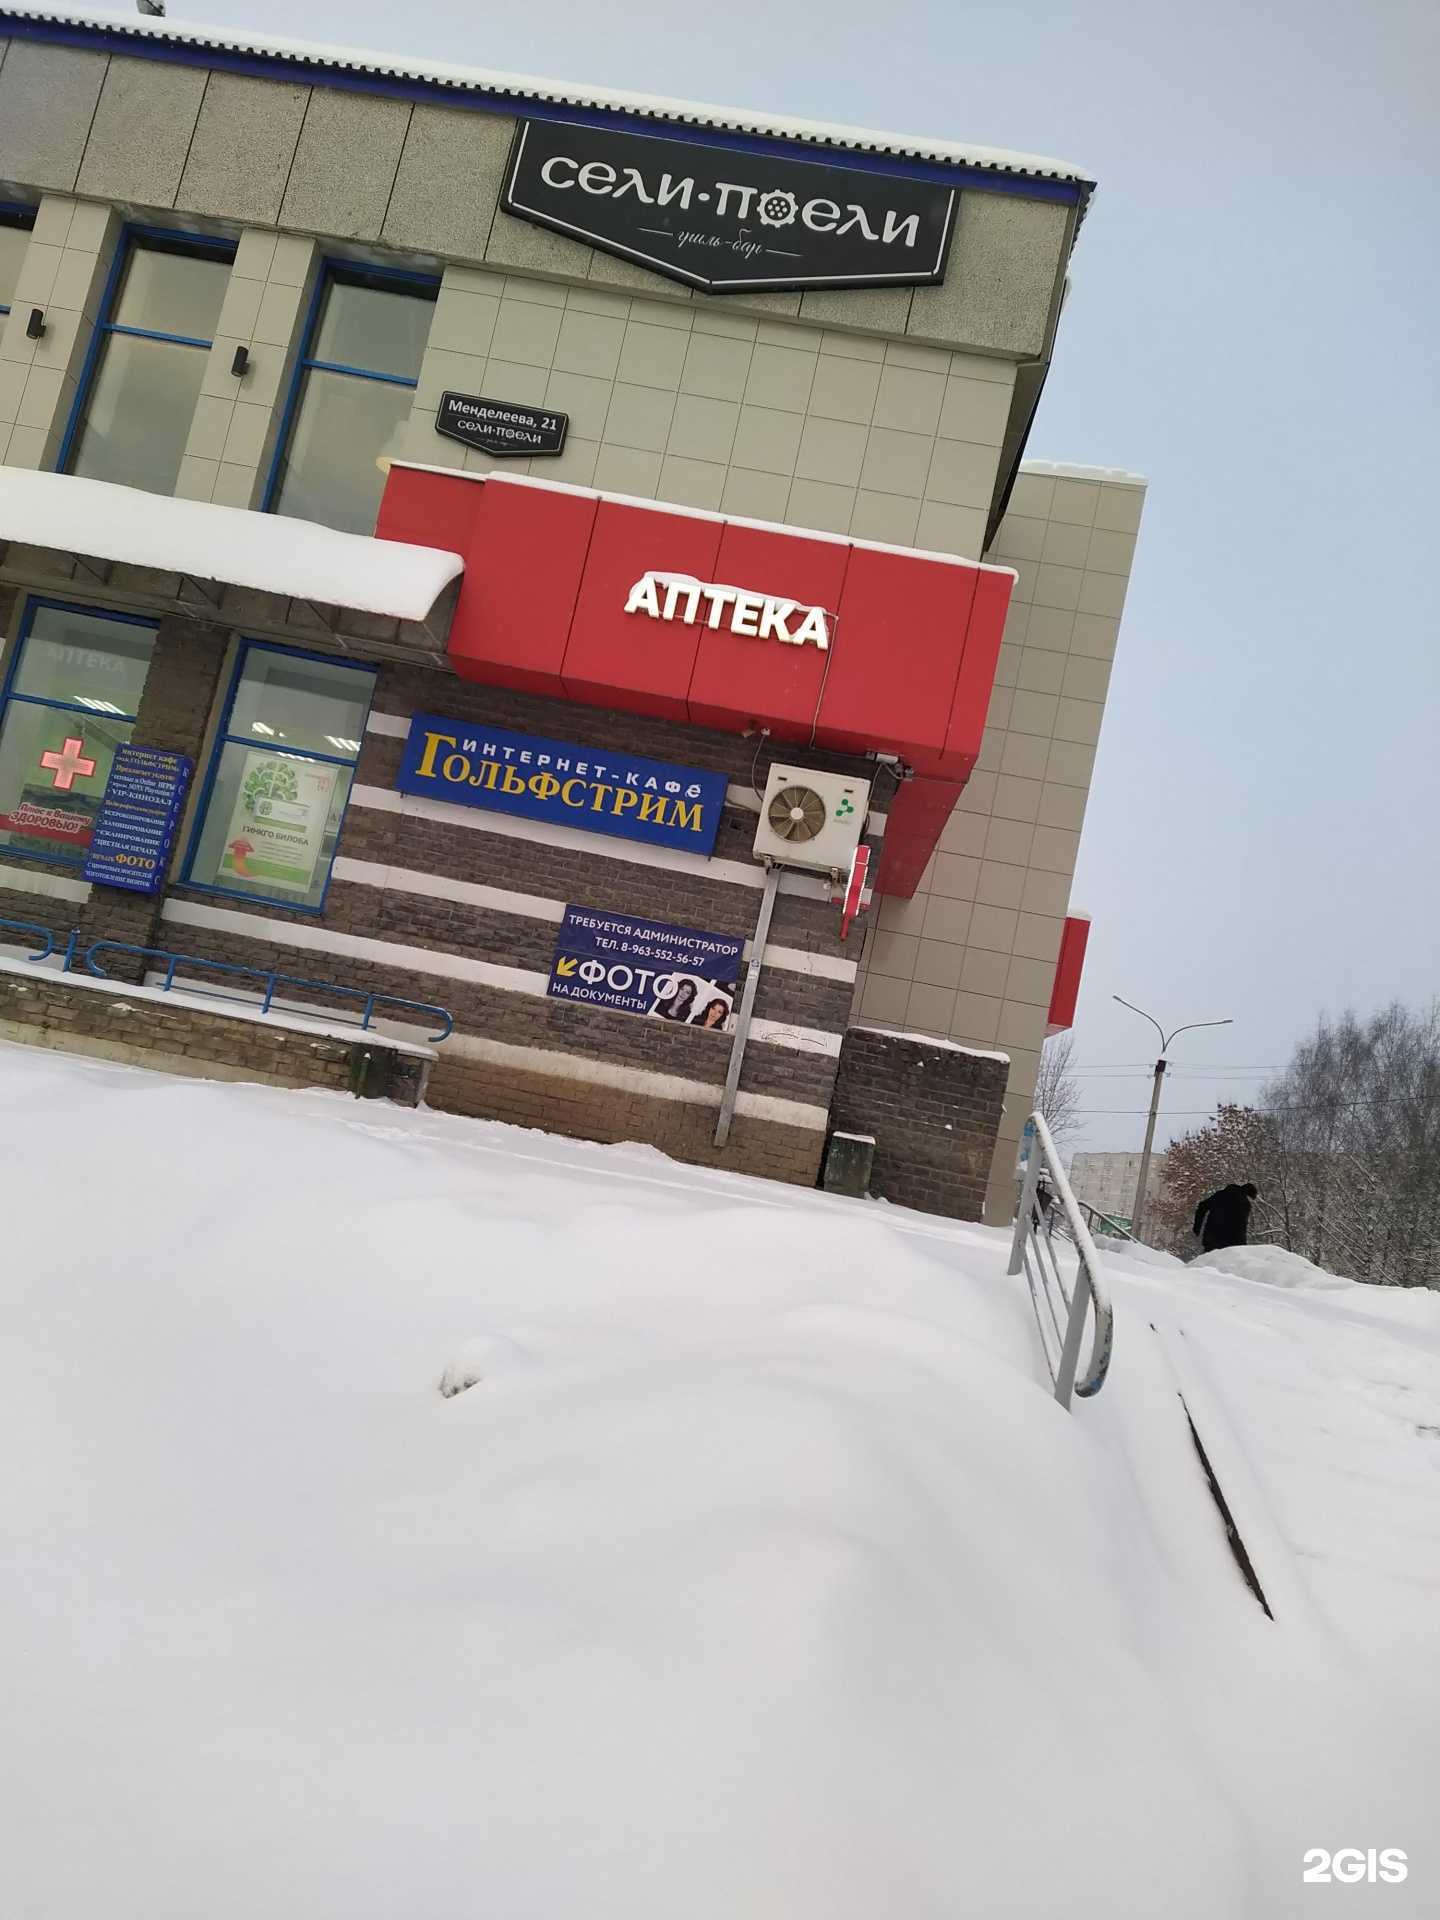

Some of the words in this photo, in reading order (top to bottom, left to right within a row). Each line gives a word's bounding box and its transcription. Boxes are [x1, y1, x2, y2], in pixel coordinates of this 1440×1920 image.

[449, 399, 537, 428] Менделеева,
[541, 417, 557, 431] 21
[623, 575, 829, 650] АПТЕКА
[415, 731, 704, 832] ГОЛЬФСТРИМ
[10, 811, 79, 832] ЗДОРОВЬЮ!
[115, 854, 156, 870] ФОТО
[569, 914, 631, 936] ТРЕБУЕТСЯ
[633, 927, 739, 956] АДМИНИСТРАТОР
[595, 936, 619, 951] ТЕЛ.
[621, 942, 705, 967] 8-963-552-56-57
[578, 959, 680, 1000] ФОТО
[552, 982, 569, 996] НА
[570, 986, 648, 1010] ДОКУМЕНТЫ
